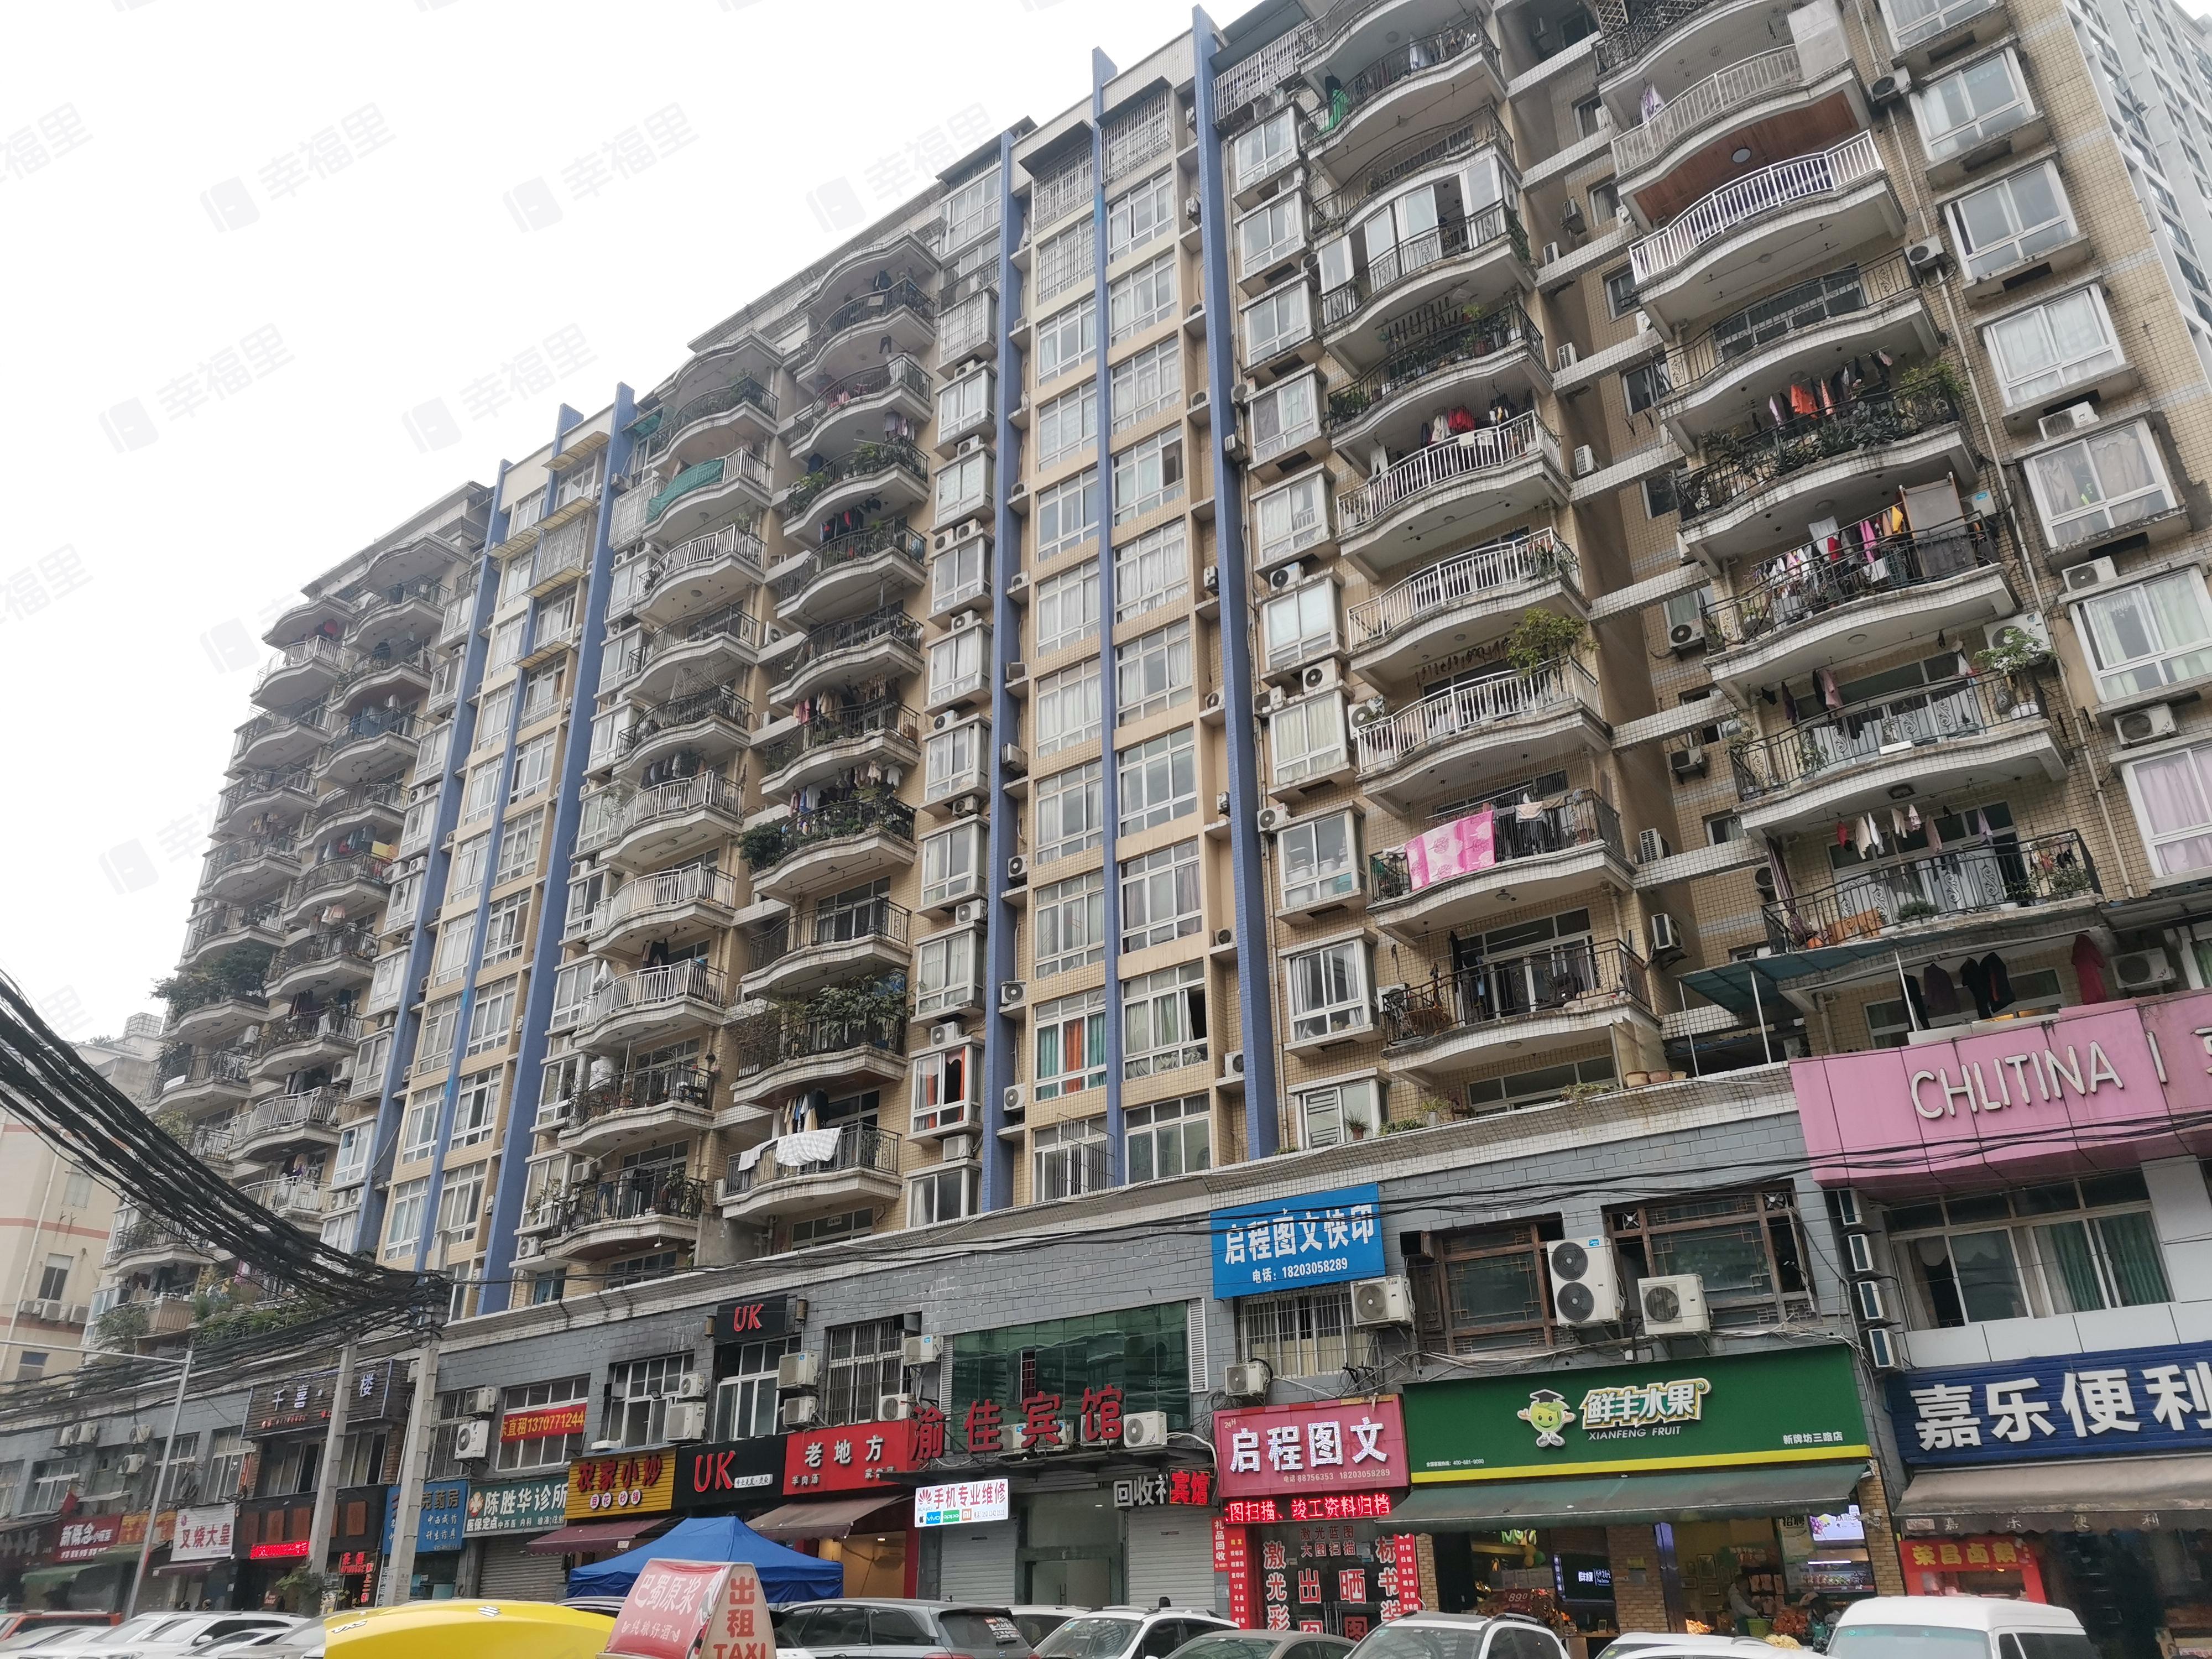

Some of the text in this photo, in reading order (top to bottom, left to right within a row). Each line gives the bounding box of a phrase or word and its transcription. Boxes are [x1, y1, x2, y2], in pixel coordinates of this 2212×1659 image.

[1911, 1040, 2125, 1119] CHLITINA
[1225, 1203, 1374, 1265] 启程图文快印
[1282, 1257, 1348, 1279] 18203058289
[733, 1303, 764, 1332] UK
[1586, 1383, 1695, 1424] 鲜丰水果
[1910, 1361, 2212, 1451] 嘉乐便利
[910, 1384, 1122, 1460] 渝佳宾馆
[1588, 1426, 1681, 1440] XIANFENG FRUIT
[1783, 1431, 1843, 1445] 新牌坊三路店
[805, 1434, 883, 1468] 老地方
[1229, 1416, 1389, 1473] 启程图文
[577, 1454, 663, 1493] 农家小炒
[694, 1451, 736, 1493] UK
[1171, 1471, 1209, 1505] 宾馆
[1283, 1468, 1390, 1483] 电话 88756353 18203058289
[483, 1483, 568, 1516] 陈胜华诊所
[933, 1482, 1005, 1509] 手机专业维修
[943, 1513, 959, 1521] oppo
[1301, 1525, 1354, 1540] 激光蓝图
[1215, 1520, 1225, 1561] 礼品回收
[1301, 1541, 1355, 1558] 大图扫描
[634, 1574, 702, 1615] 巴蜀原浆
[726, 1576, 755, 1638] 出租
[713, 1642, 766, 1659] TAXI
